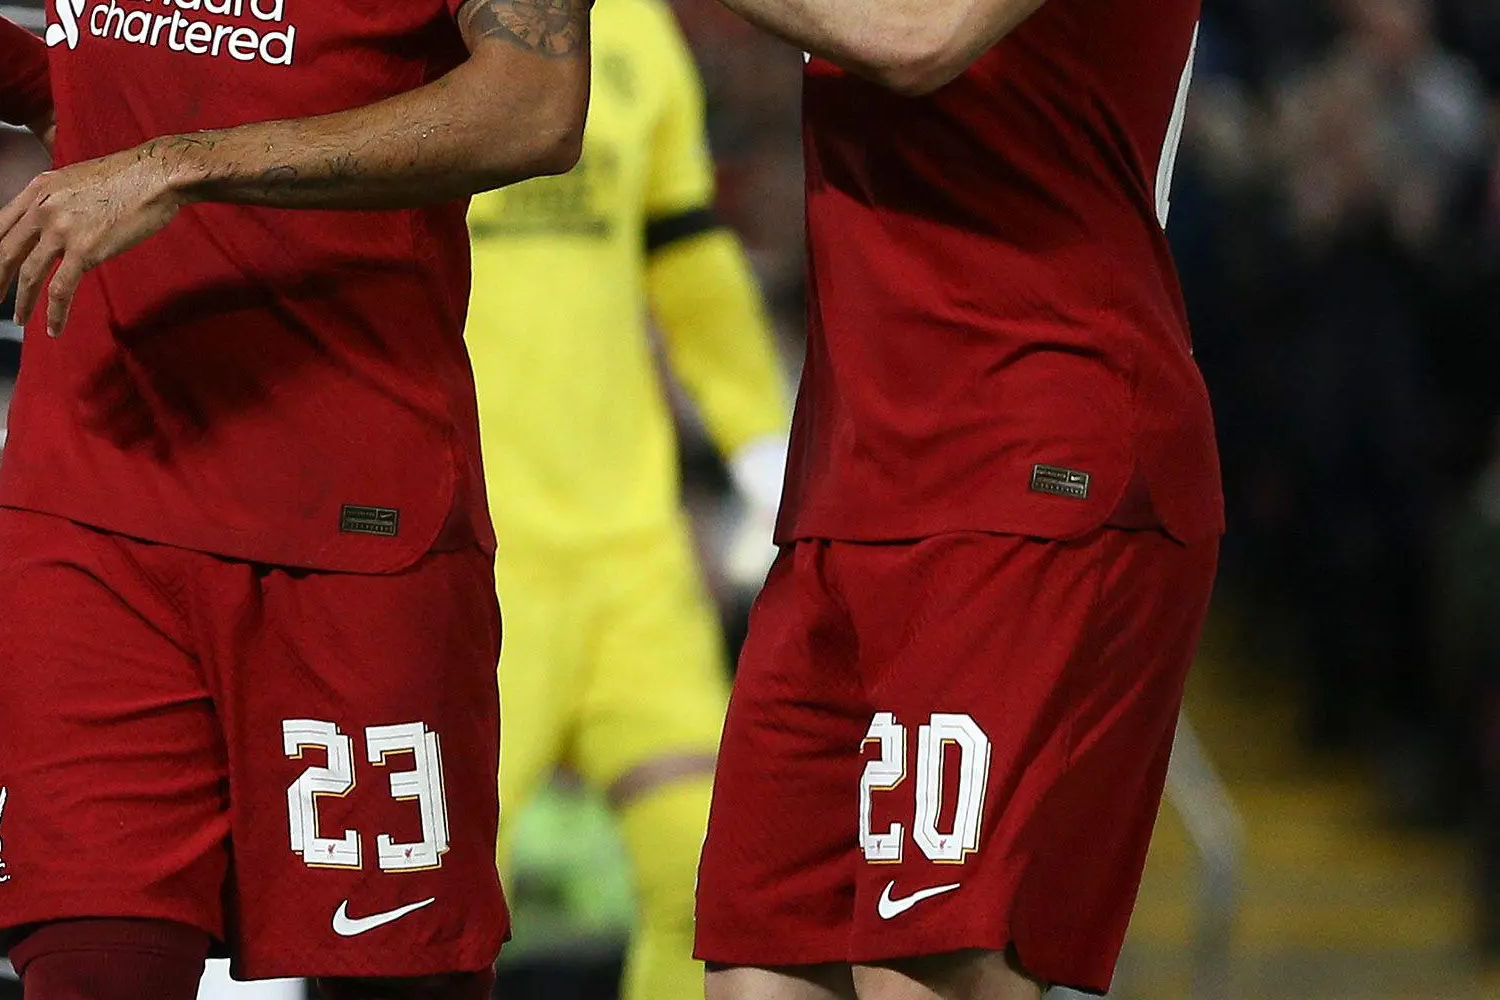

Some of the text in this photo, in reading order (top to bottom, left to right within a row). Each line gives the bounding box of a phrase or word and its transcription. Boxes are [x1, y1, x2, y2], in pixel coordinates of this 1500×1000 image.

[90, 0, 296, 65] chartered
[282, 719, 450, 873] 23
[859, 712, 992, 865] 20
